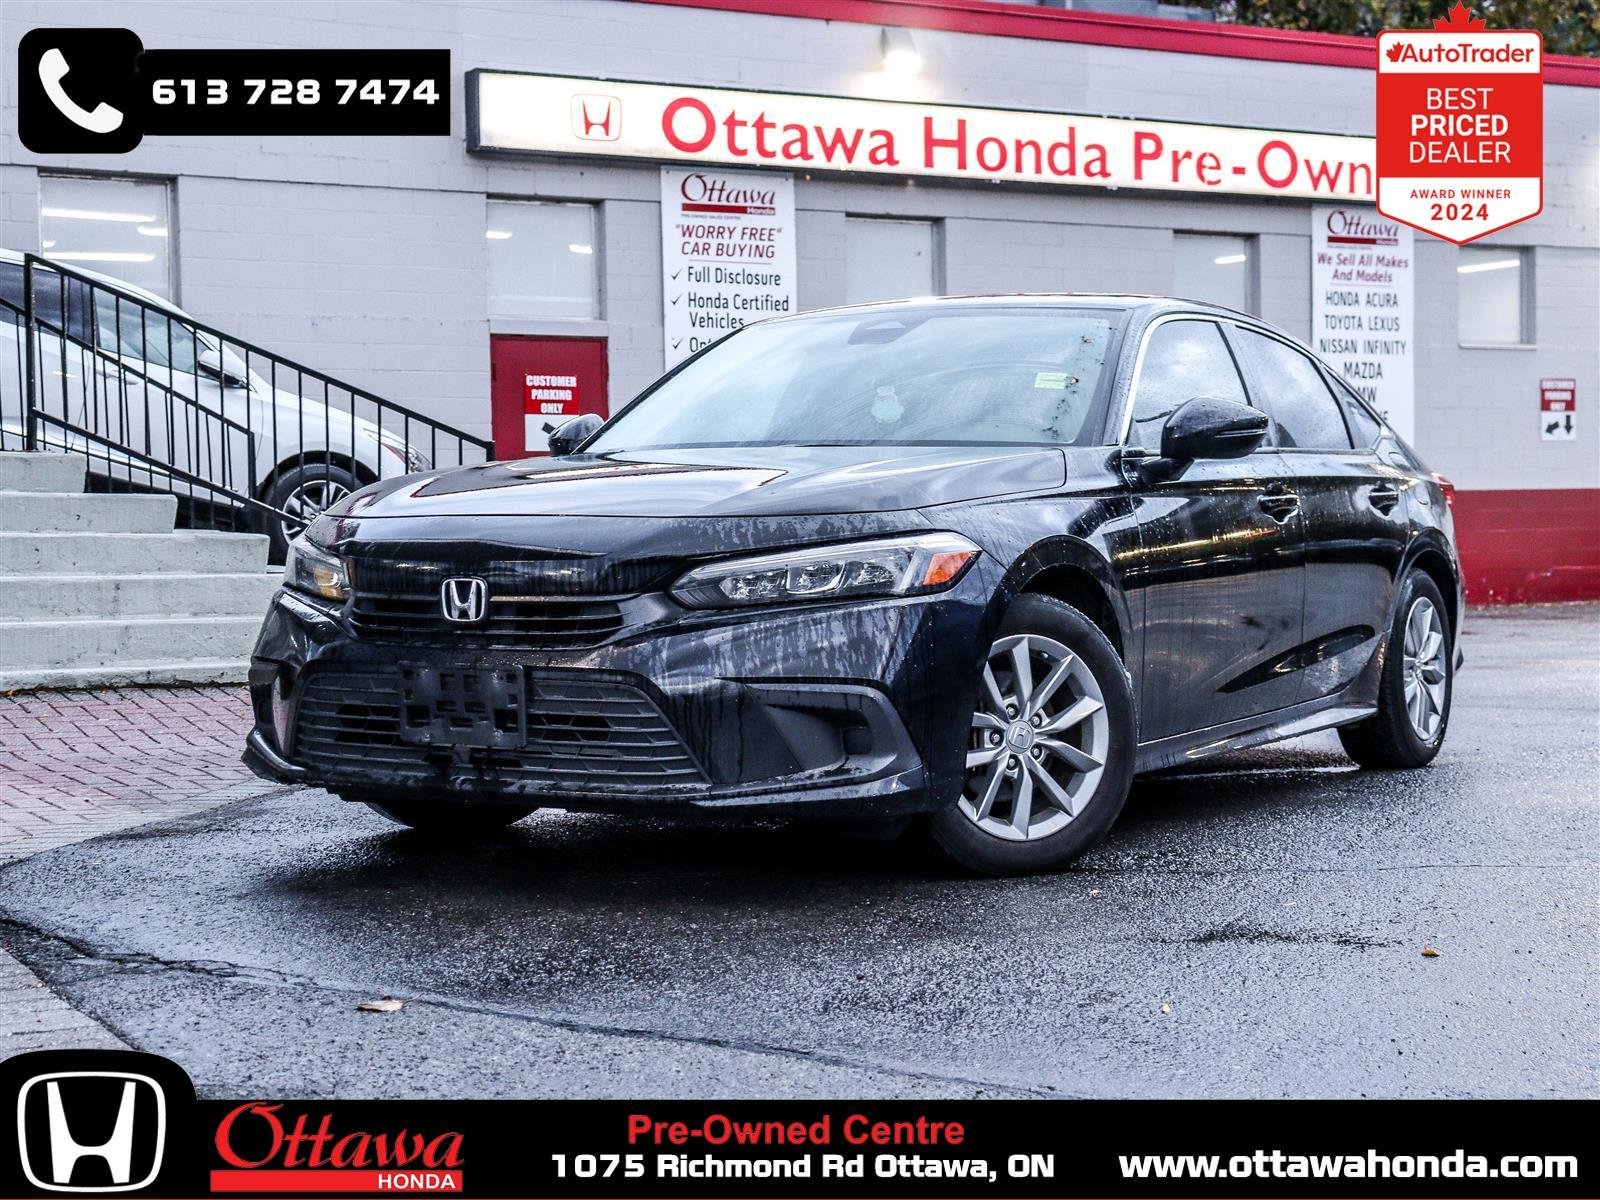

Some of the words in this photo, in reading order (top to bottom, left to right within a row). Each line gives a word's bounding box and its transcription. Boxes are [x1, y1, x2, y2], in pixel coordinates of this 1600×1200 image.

[661, 97, 900, 167] Ottawa
[923, 116, 1111, 179] Honda
[1133, 131, 1372, 195] Pre-Own
[681, 173, 776, 205] Ottawa
[1327, 209, 1398, 237] Ottawa
[681, 241, 711, 256] CAR
[715, 243, 775, 258] BUYING
[1317, 252, 1332, 265] We
[1336, 252, 1356, 266] Sell
[1358, 253, 1373, 267] All
[1376, 254, 1409, 268] Makes
[687, 266, 710, 283] Full
[715, 268, 781, 286] Disclosure
[1332, 268, 1353, 281] And
[1356, 269, 1392, 283] Models
[688, 291, 729, 309] Honda
[733, 293, 789, 312] Certified
[1326, 291, 1359, 306] HONDA
[1365, 292, 1399, 308] ACURA
[689, 311, 744, 329] Vehicles
[1325, 314, 1363, 330] TOYOTA
[1368, 316, 1400, 332] LEXUS
[1320, 339, 1358, 354] NISSAN
[1363, 340, 1406, 355] INFINITY
[1344, 362, 1383, 379] MAZDA
[525, 375, 577, 387] CUSTOMER
[531, 389, 573, 401] PARKING
[540, 402, 564, 413] ONLY
